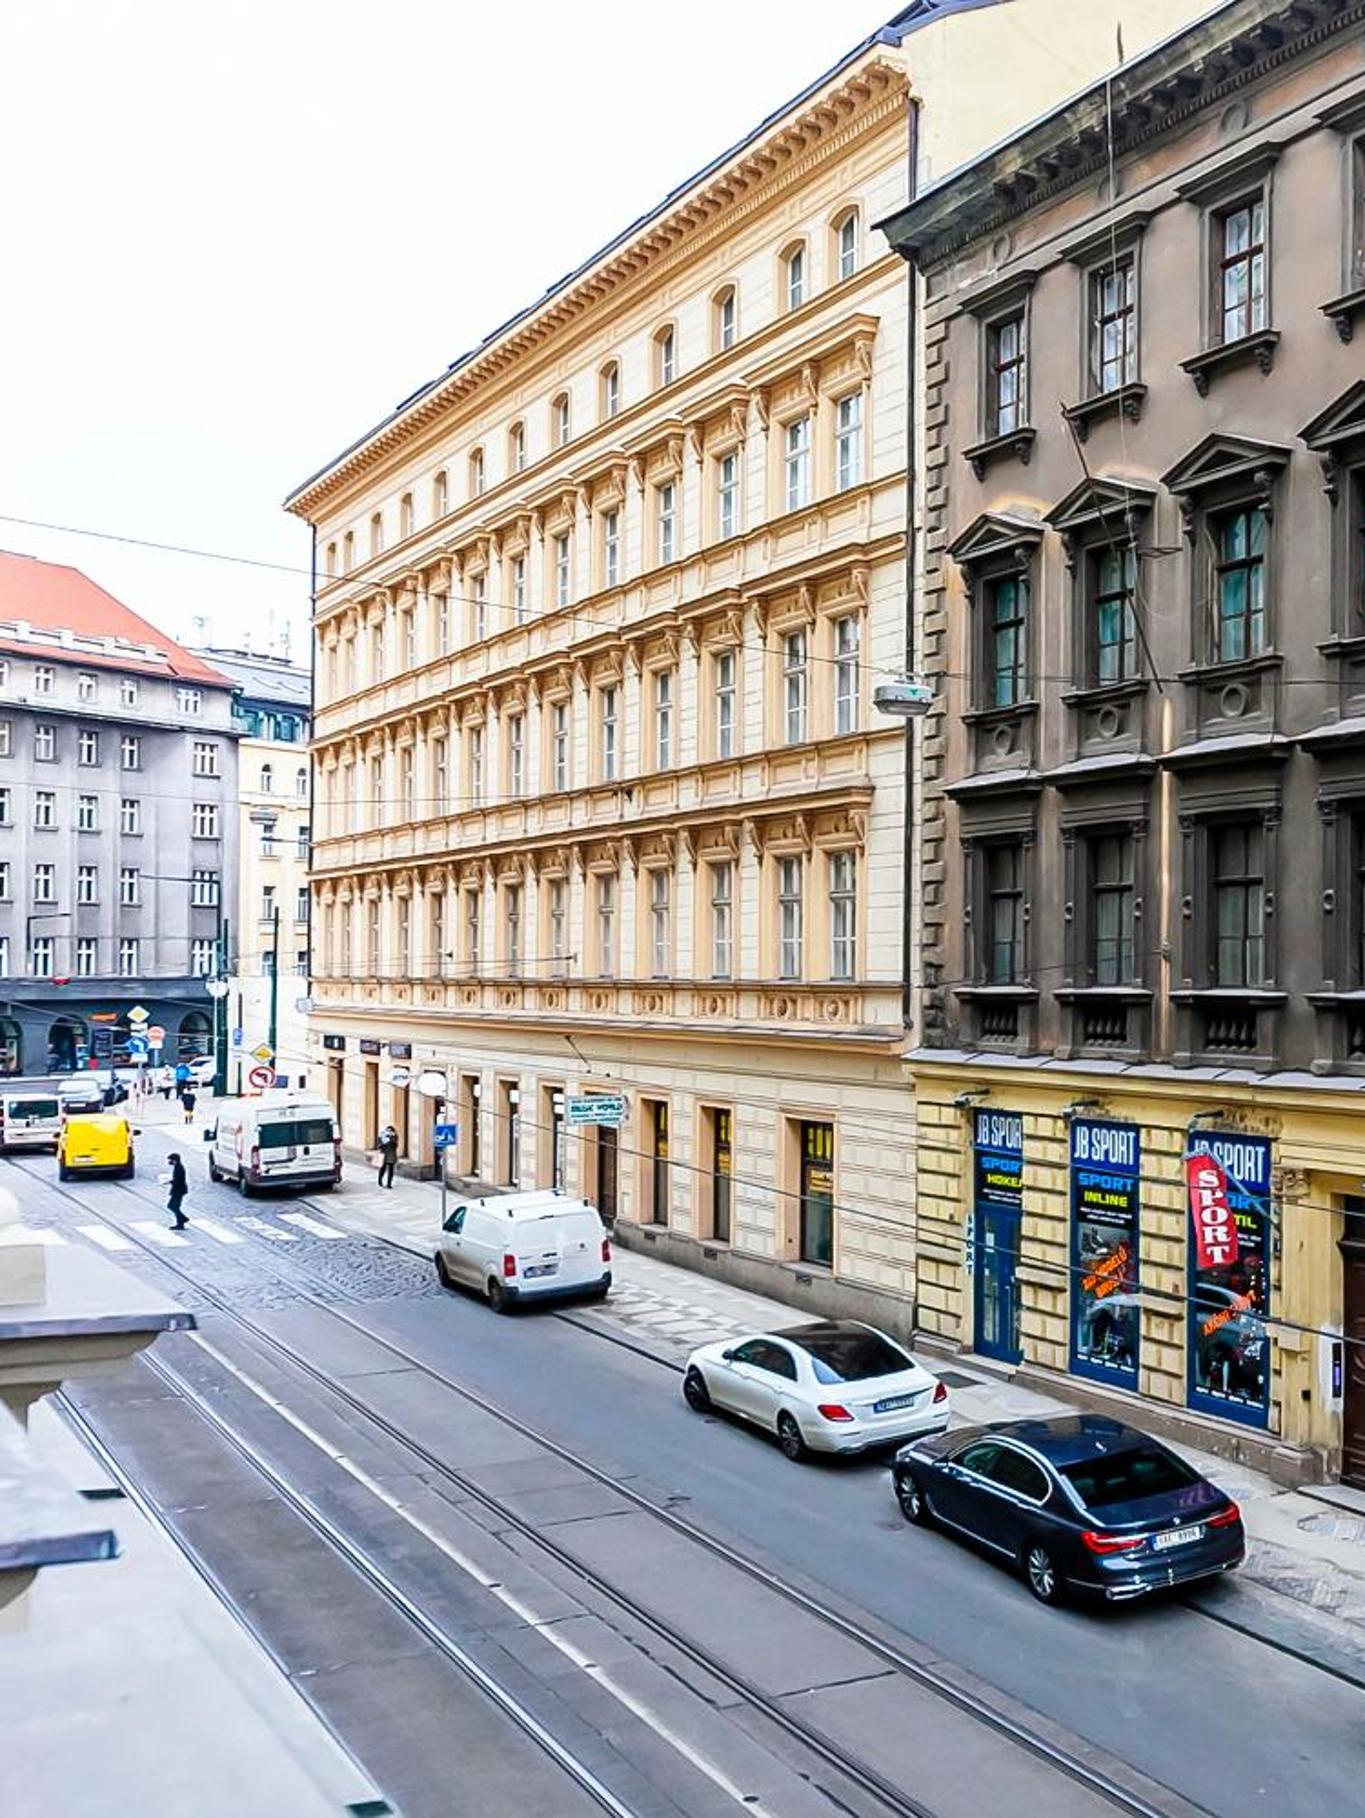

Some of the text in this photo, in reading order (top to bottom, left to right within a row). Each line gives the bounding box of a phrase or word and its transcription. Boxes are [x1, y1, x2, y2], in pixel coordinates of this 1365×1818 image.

[977, 1115, 1022, 1149] JB SPOR
[1074, 1126, 1136, 1165] JB SPORT
[981, 1157, 1021, 1173] SPOR
[1213, 1142, 1265, 1183] SPORT
[1078, 1173, 1135, 1192] SPORT
[1084, 1191, 1128, 1207] INLINE
[1197, 1169, 1231, 1264] SPORT
[1233, 1213, 1258, 1229] TIL
